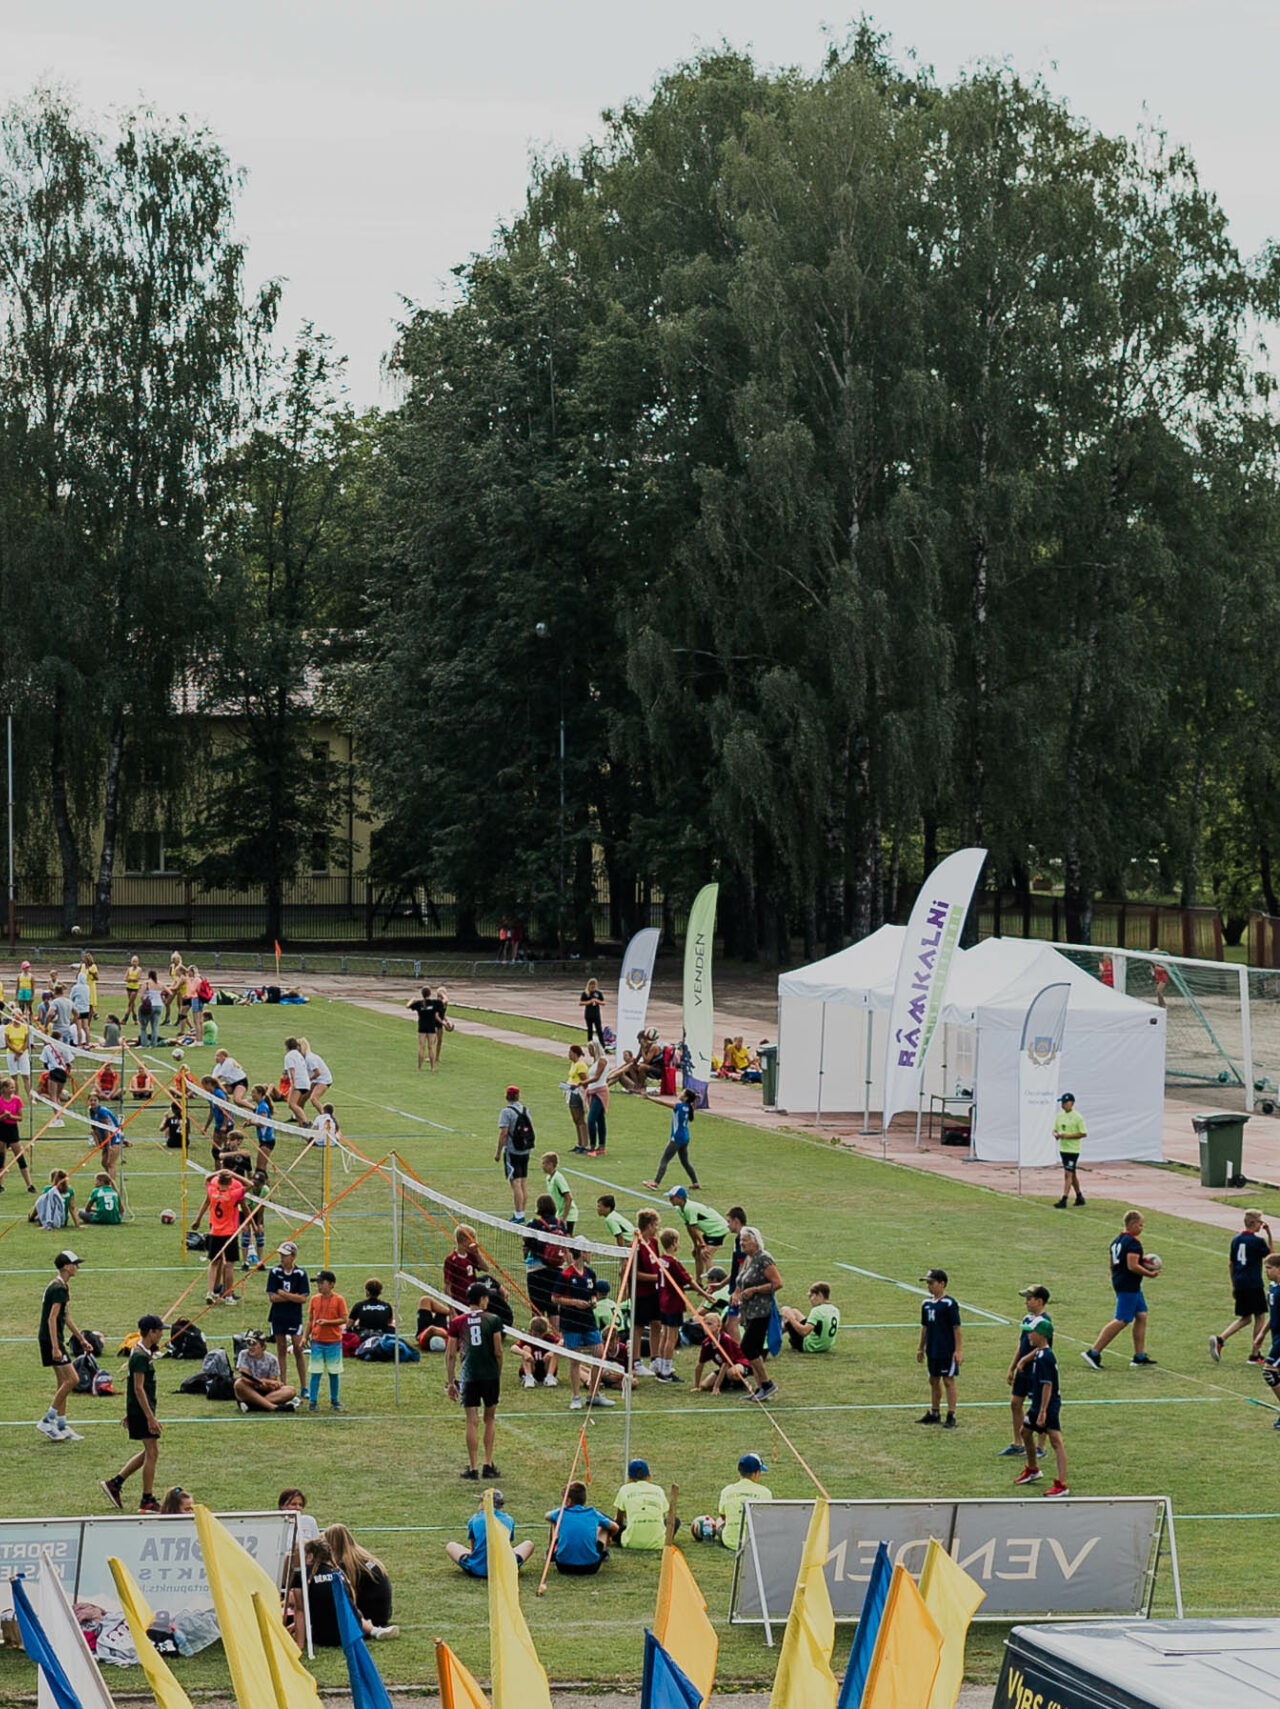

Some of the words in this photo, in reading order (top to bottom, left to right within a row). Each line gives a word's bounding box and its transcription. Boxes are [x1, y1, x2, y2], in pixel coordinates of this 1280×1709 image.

[695, 933, 705, 1007] VENDEN
[104, 1196, 114, 1211] 5
[215, 1201, 224, 1219] 6
[1237, 1244, 1247, 1265] 4
[470, 1325, 482, 1346] 8
[828, 1317, 838, 1337] 8
